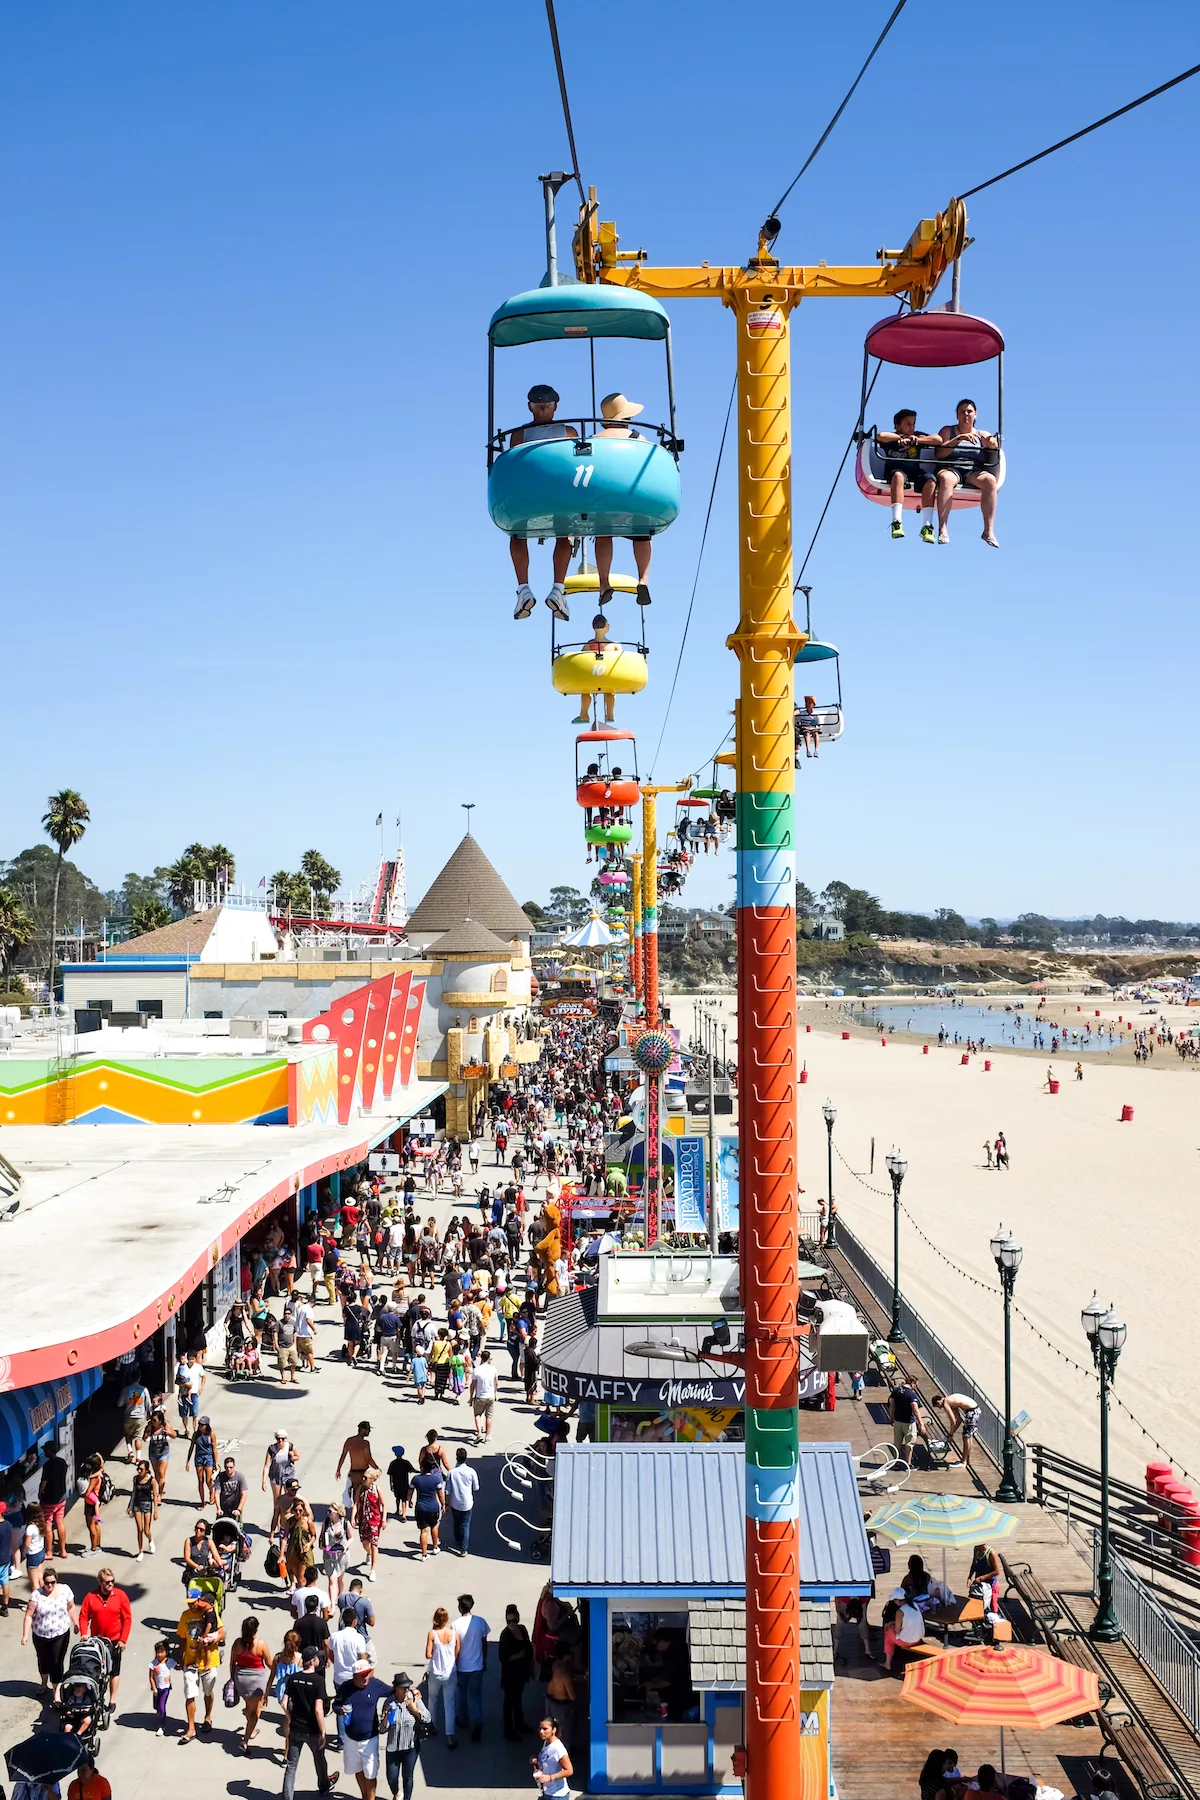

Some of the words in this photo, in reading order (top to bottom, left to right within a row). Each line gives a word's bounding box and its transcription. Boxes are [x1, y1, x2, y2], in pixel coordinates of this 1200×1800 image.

[573, 464, 594, 487] 11
[592, 664, 606, 676] 10
[604, 790, 612, 798] 9
[549, 1008, 593, 1016] DIPPER
[680, 1138, 700, 1229] Boardwalk
[722, 1202, 730, 1229] COOL
[575, 1377, 643, 1402] TAFFY
